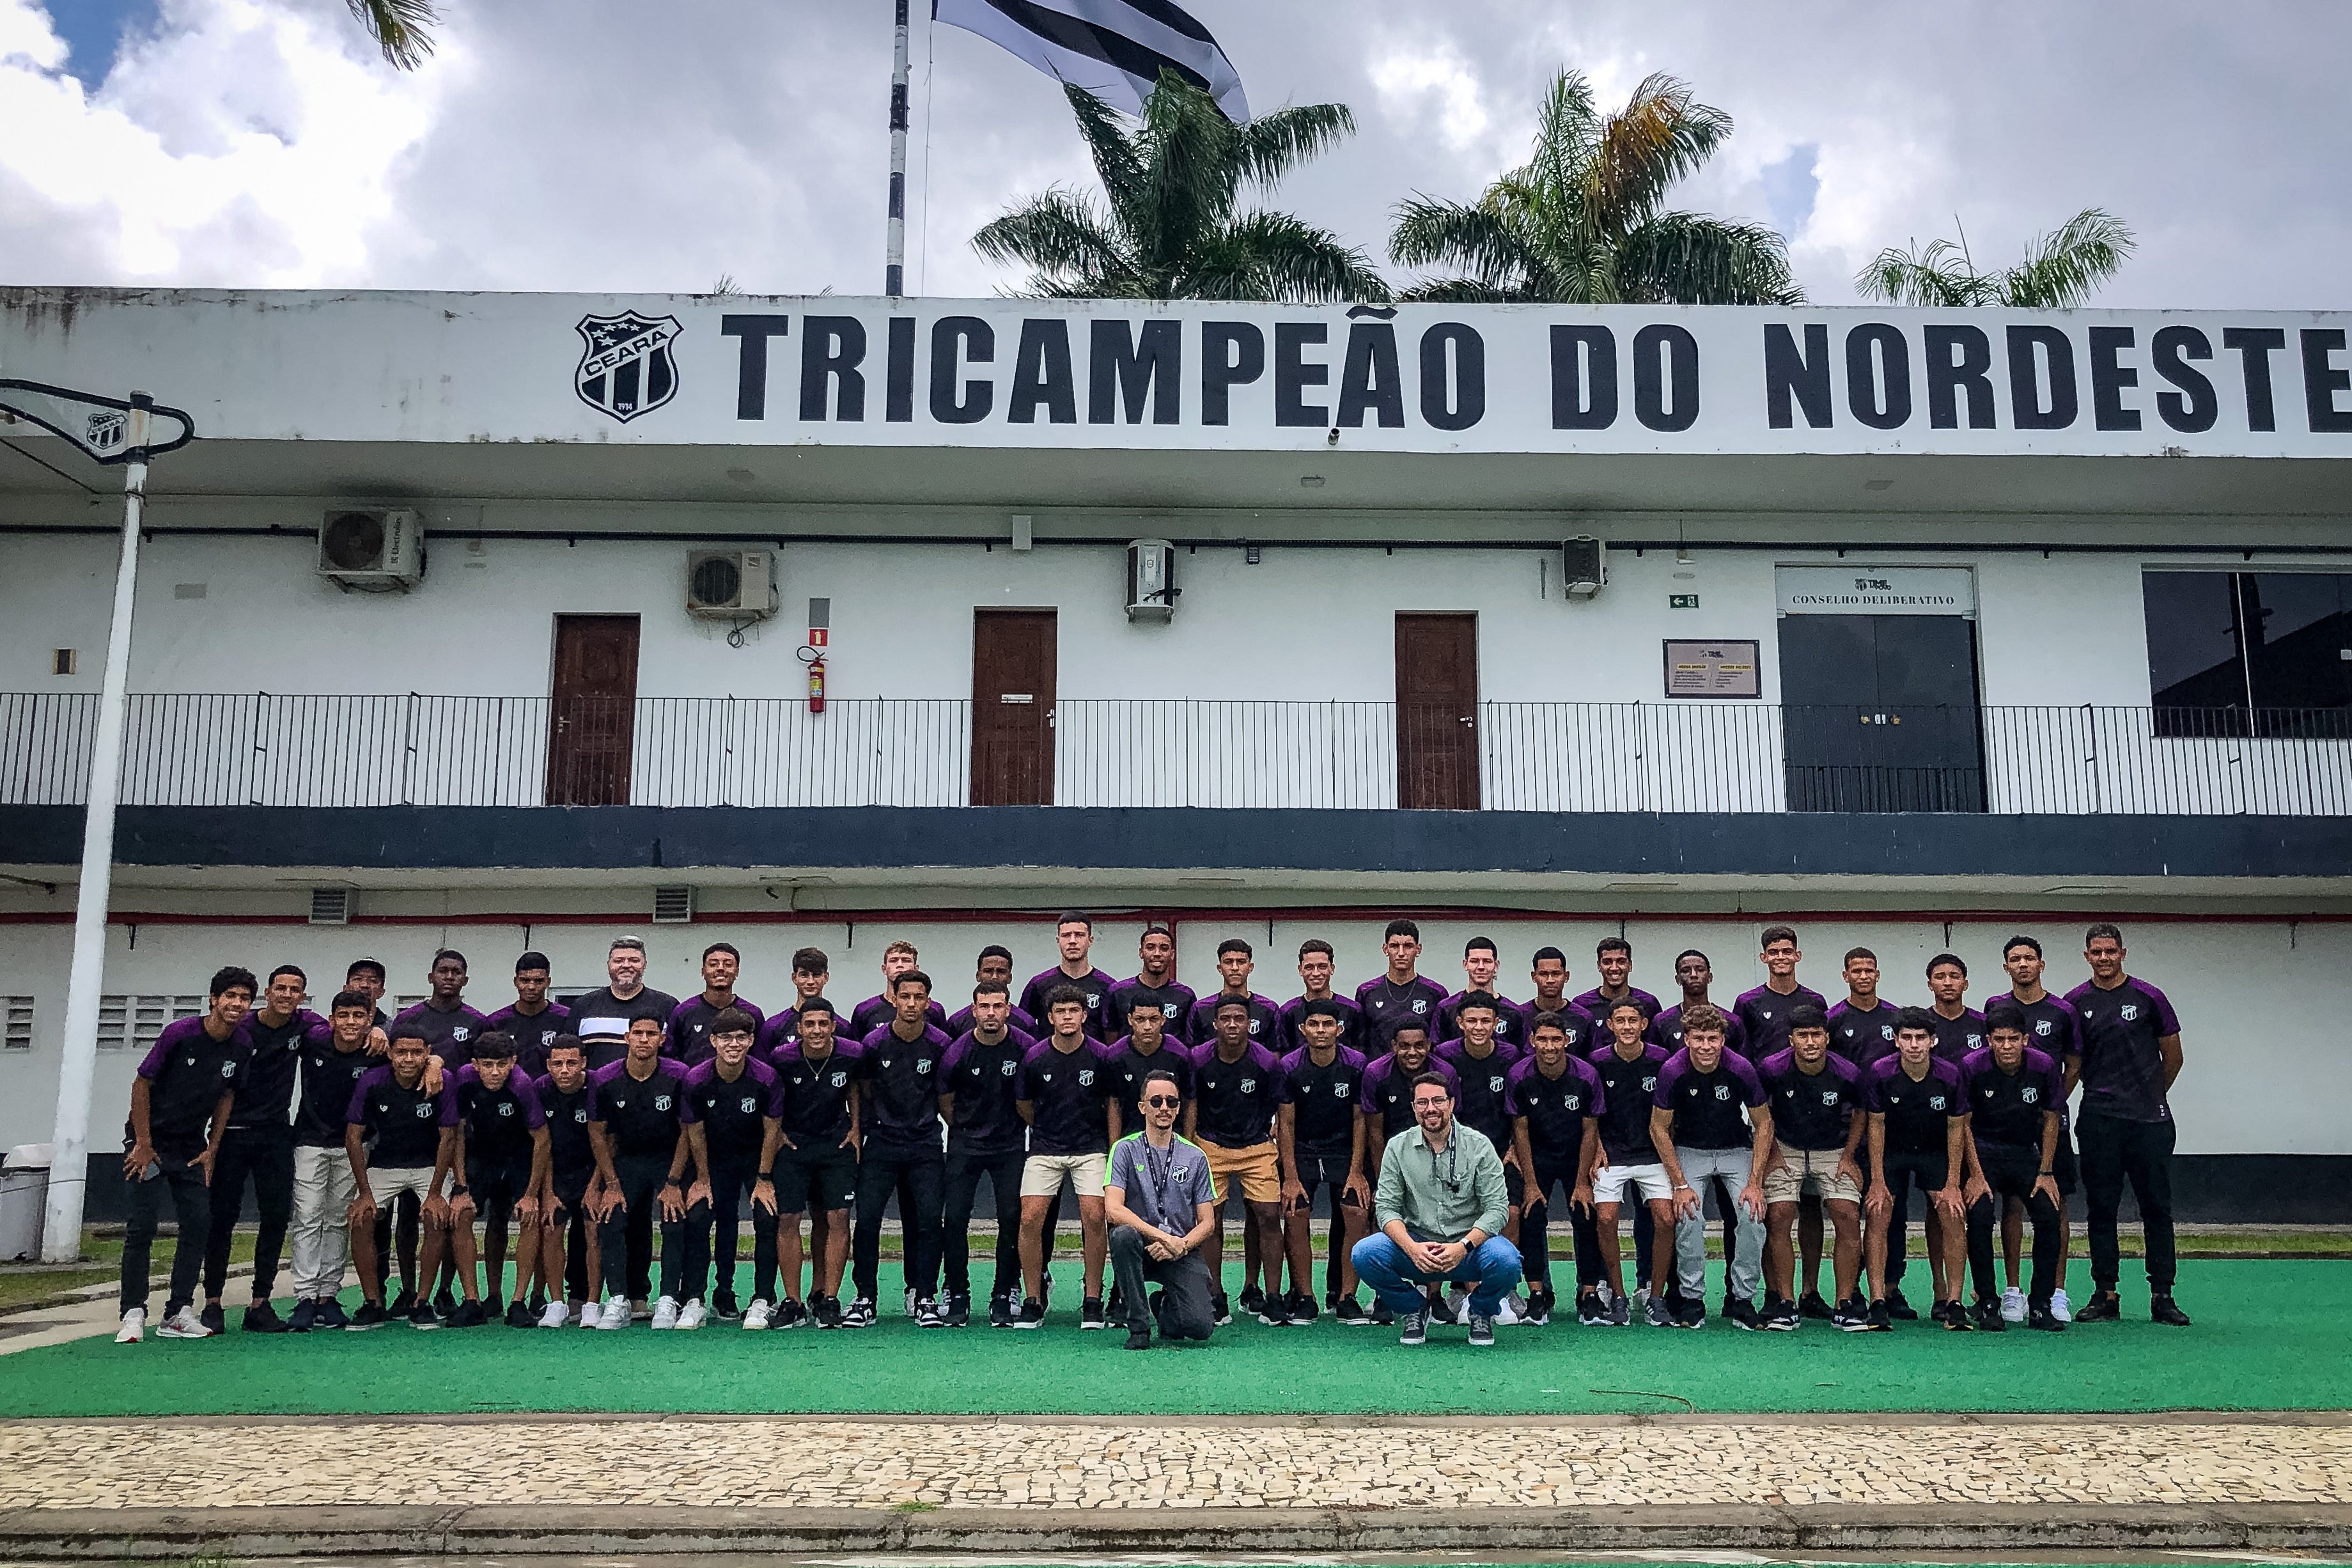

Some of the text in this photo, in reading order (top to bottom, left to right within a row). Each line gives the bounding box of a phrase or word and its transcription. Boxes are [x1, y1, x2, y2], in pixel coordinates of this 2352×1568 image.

[721, 306, 2352, 434] TRICAMPEÃO DO NORDESTE
[1792, 595, 1954, 605] CONSELHO DELIBERATIVO
